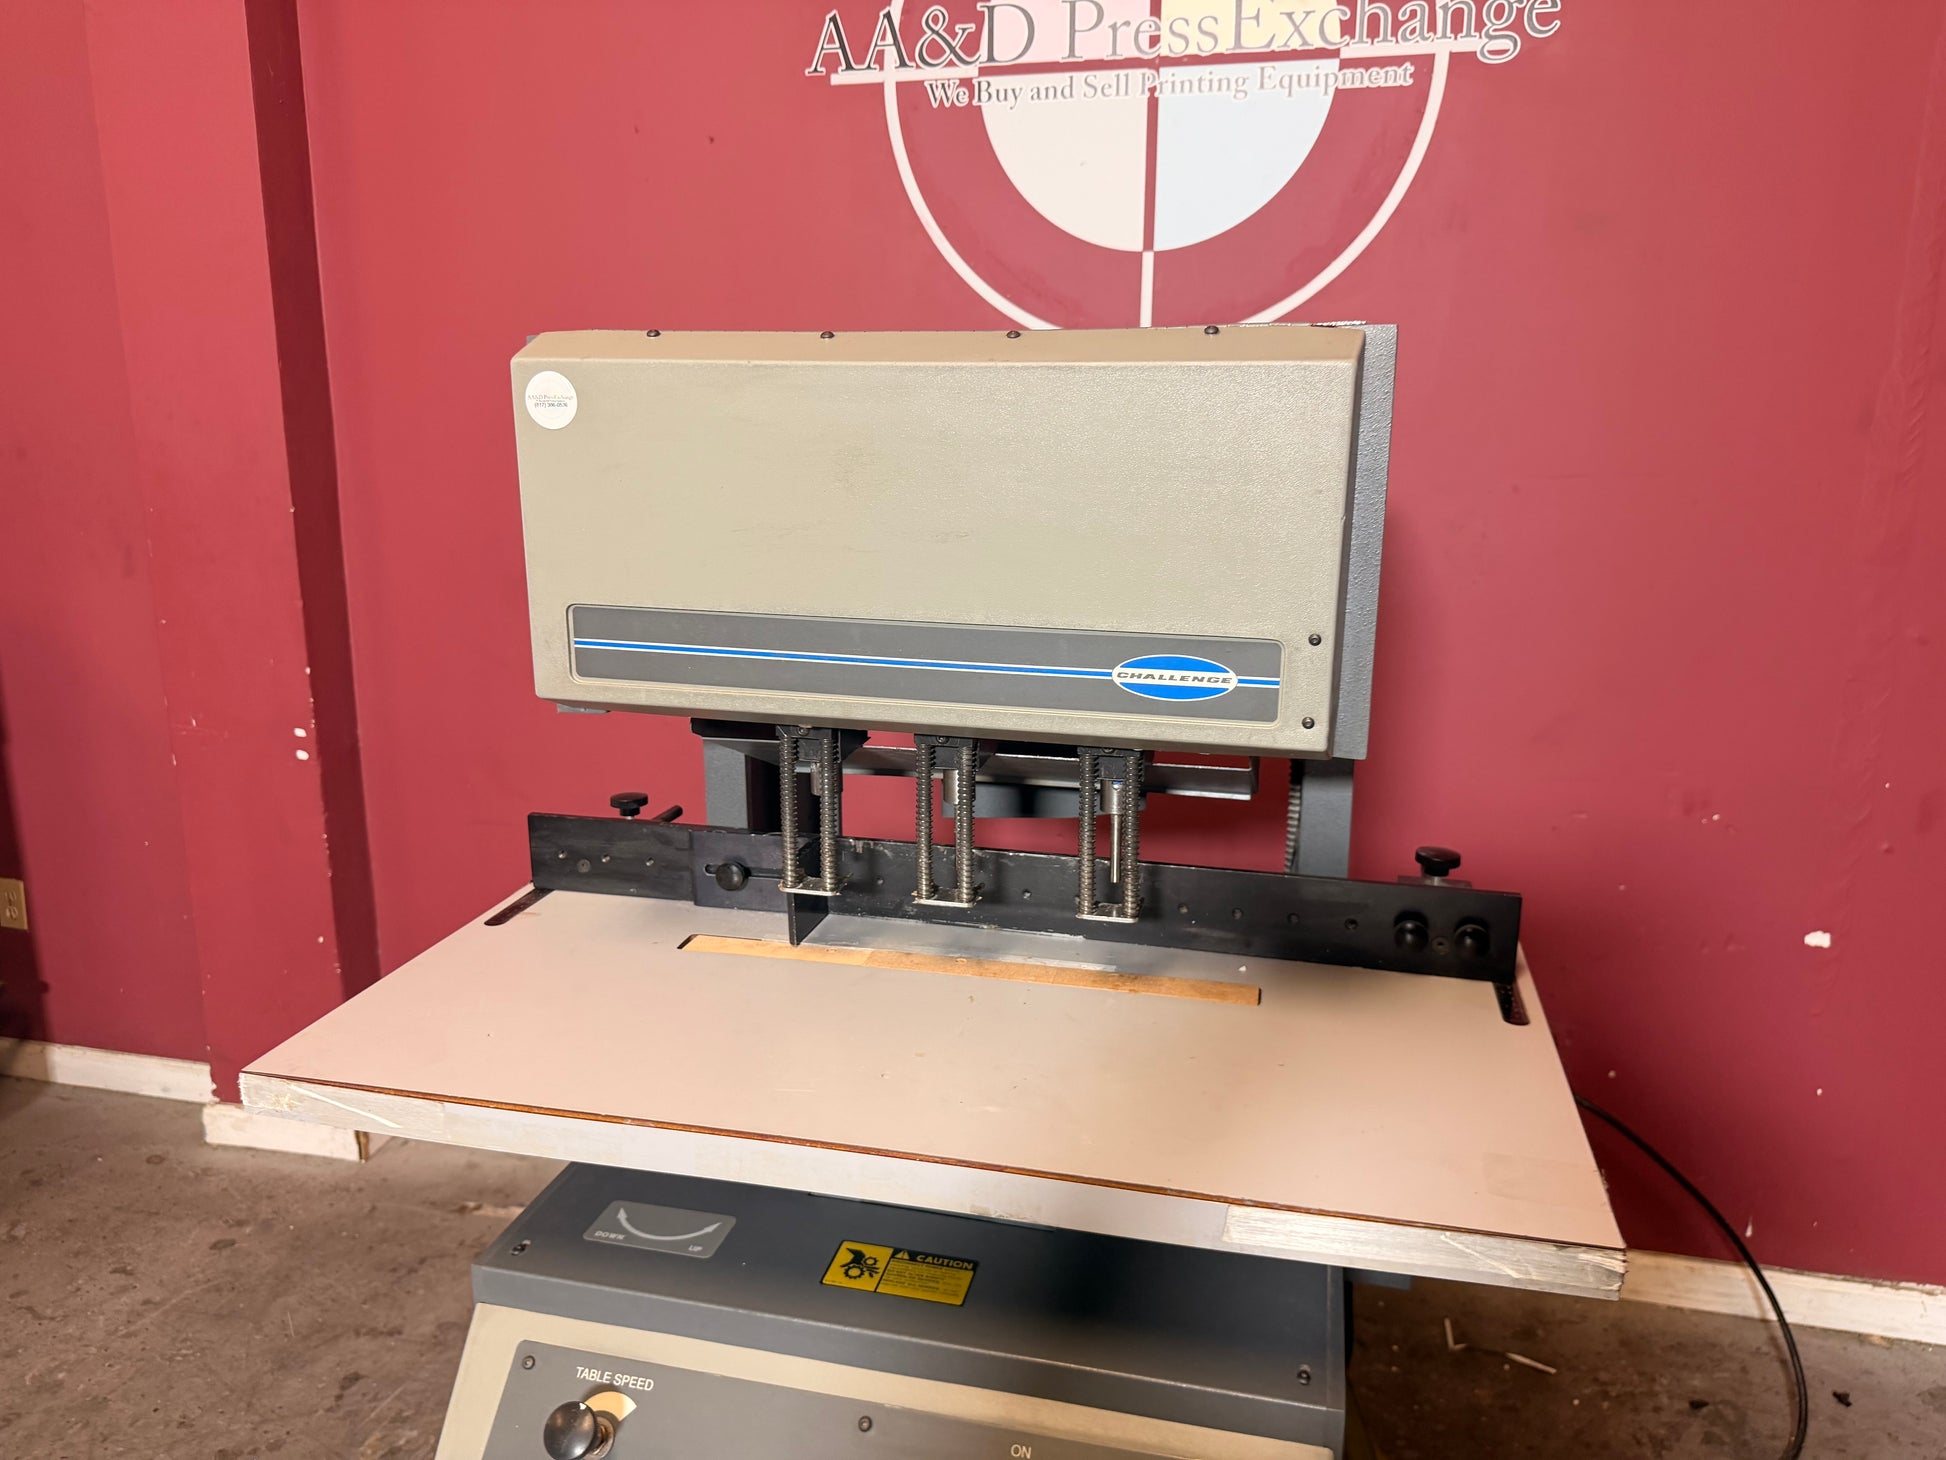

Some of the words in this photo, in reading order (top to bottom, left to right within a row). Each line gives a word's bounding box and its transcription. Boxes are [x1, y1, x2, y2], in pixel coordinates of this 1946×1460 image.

[806, 2, 1035, 75] AA&D
[927, 80, 968, 106] We
[974, 79, 1023, 110] Buy
[1030, 76, 1075, 102] and
[1083, 73, 1130, 98] Sell
[1138, 66, 1249, 100] Printing
[1258, 62, 1414, 98] Equipment
[1117, 671, 1232, 684] CHALLENGE
[594, 1230, 625, 1240] DOWN
[688, 1244, 703, 1252] UP
[916, 1254, 974, 1270] CAUTION
[576, 1366, 612, 1384] TABLE
[613, 1373, 655, 1391] SPEED
[1010, 1443, 1032, 1459] ON
